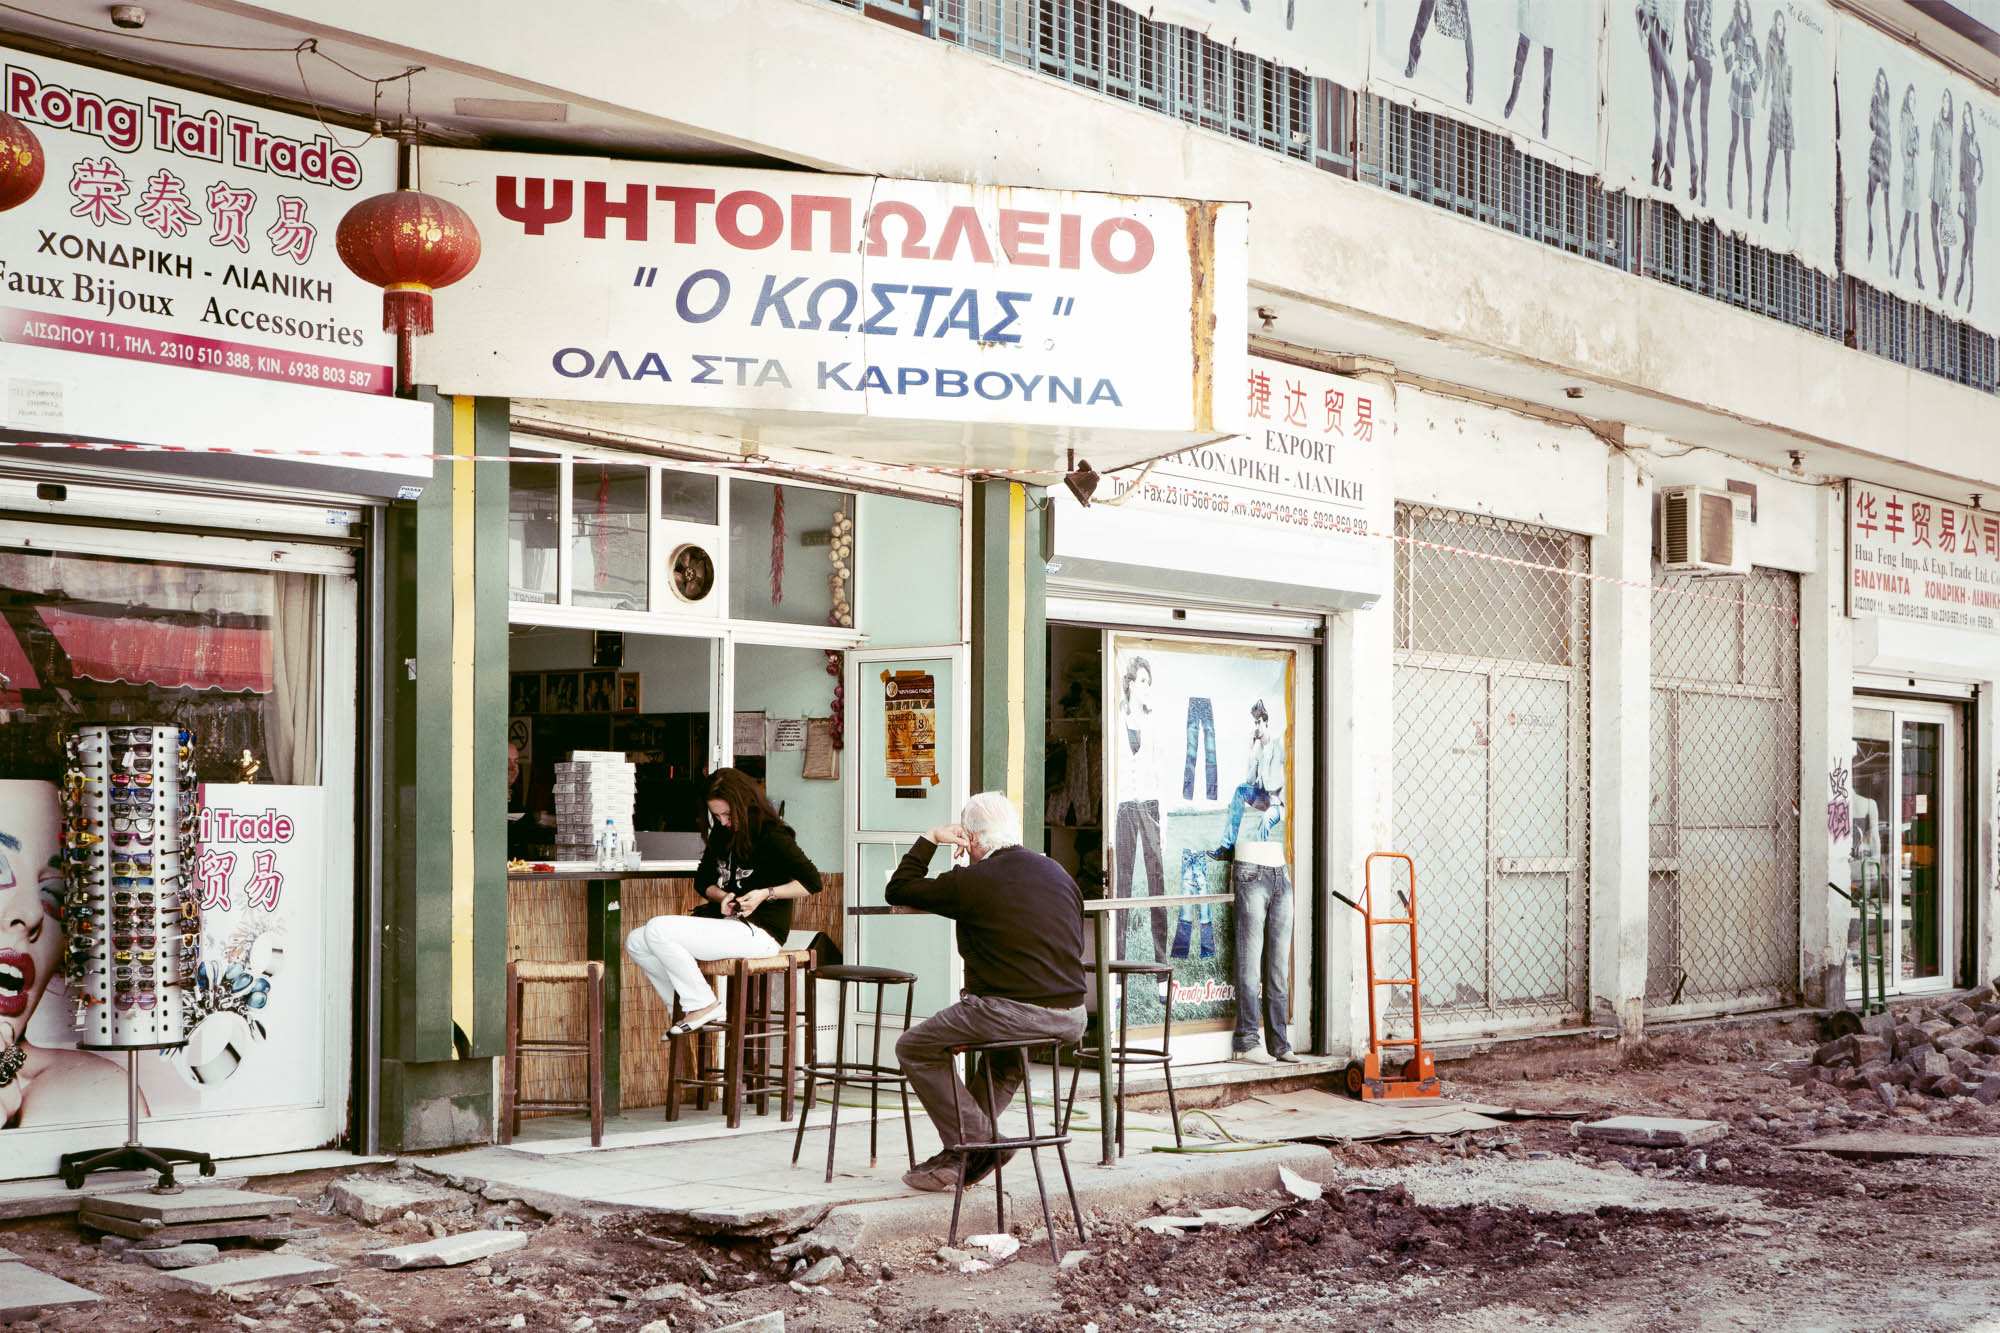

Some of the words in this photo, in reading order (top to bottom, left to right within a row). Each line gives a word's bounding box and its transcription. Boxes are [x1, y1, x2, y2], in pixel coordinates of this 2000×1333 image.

[8, 68, 140, 149] Rong
[151, 101, 221, 158] Tai
[231, 119, 360, 187] Trade
[71, 159, 316, 263] 荣泰贸易
[495, 174, 1155, 275] ΨΗΤΟΠΩΛΕΙΟ
[37, 228, 193, 280] ΧΟΝΔΡΙΚΗ
[222, 263, 333, 304] ΛΙΑΝΙΚΗ
[72, 272, 175, 317] Bijoux
[200, 296, 365, 347] Accessories
[23, 320, 94, 346] ΑΙΣΩΠΟΥ
[100, 332, 121, 352] 11,
[125, 336, 155, 356] ΤΗΛ.
[160, 341, 194, 362] 2310
[198, 346, 223, 366] 510
[226, 350, 254, 372] 388,
[258, 356, 285, 376] ΚΙΝ.
[288, 360, 320, 380] 6938
[322, 365, 346, 384] 803
[349, 369, 372, 388] 587
[552, 347, 673, 383] ΟΛΑ
[690, 354, 793, 389] ΣΤΑ
[817, 360, 1124, 408] ΚΑΡΒΟΥΝΑ
[1247, 368, 1374, 443] 捷达贸易
[1188, 448, 1280, 485] ΧΟΝΔΡΙΚΗ
[1292, 471, 1364, 502] ΛΙΑΝΙΚΗ
[1265, 429, 1337, 465] EXPORT
[1855, 543, 1874, 562] Hua
[1878, 547, 1897, 568] Feng
[1856, 491, 2000, 563] 华丰贸易公司
[1854, 567, 1911, 596] ΕΝΔΥΜΑΤΑ
[216, 810, 293, 841] Trade
